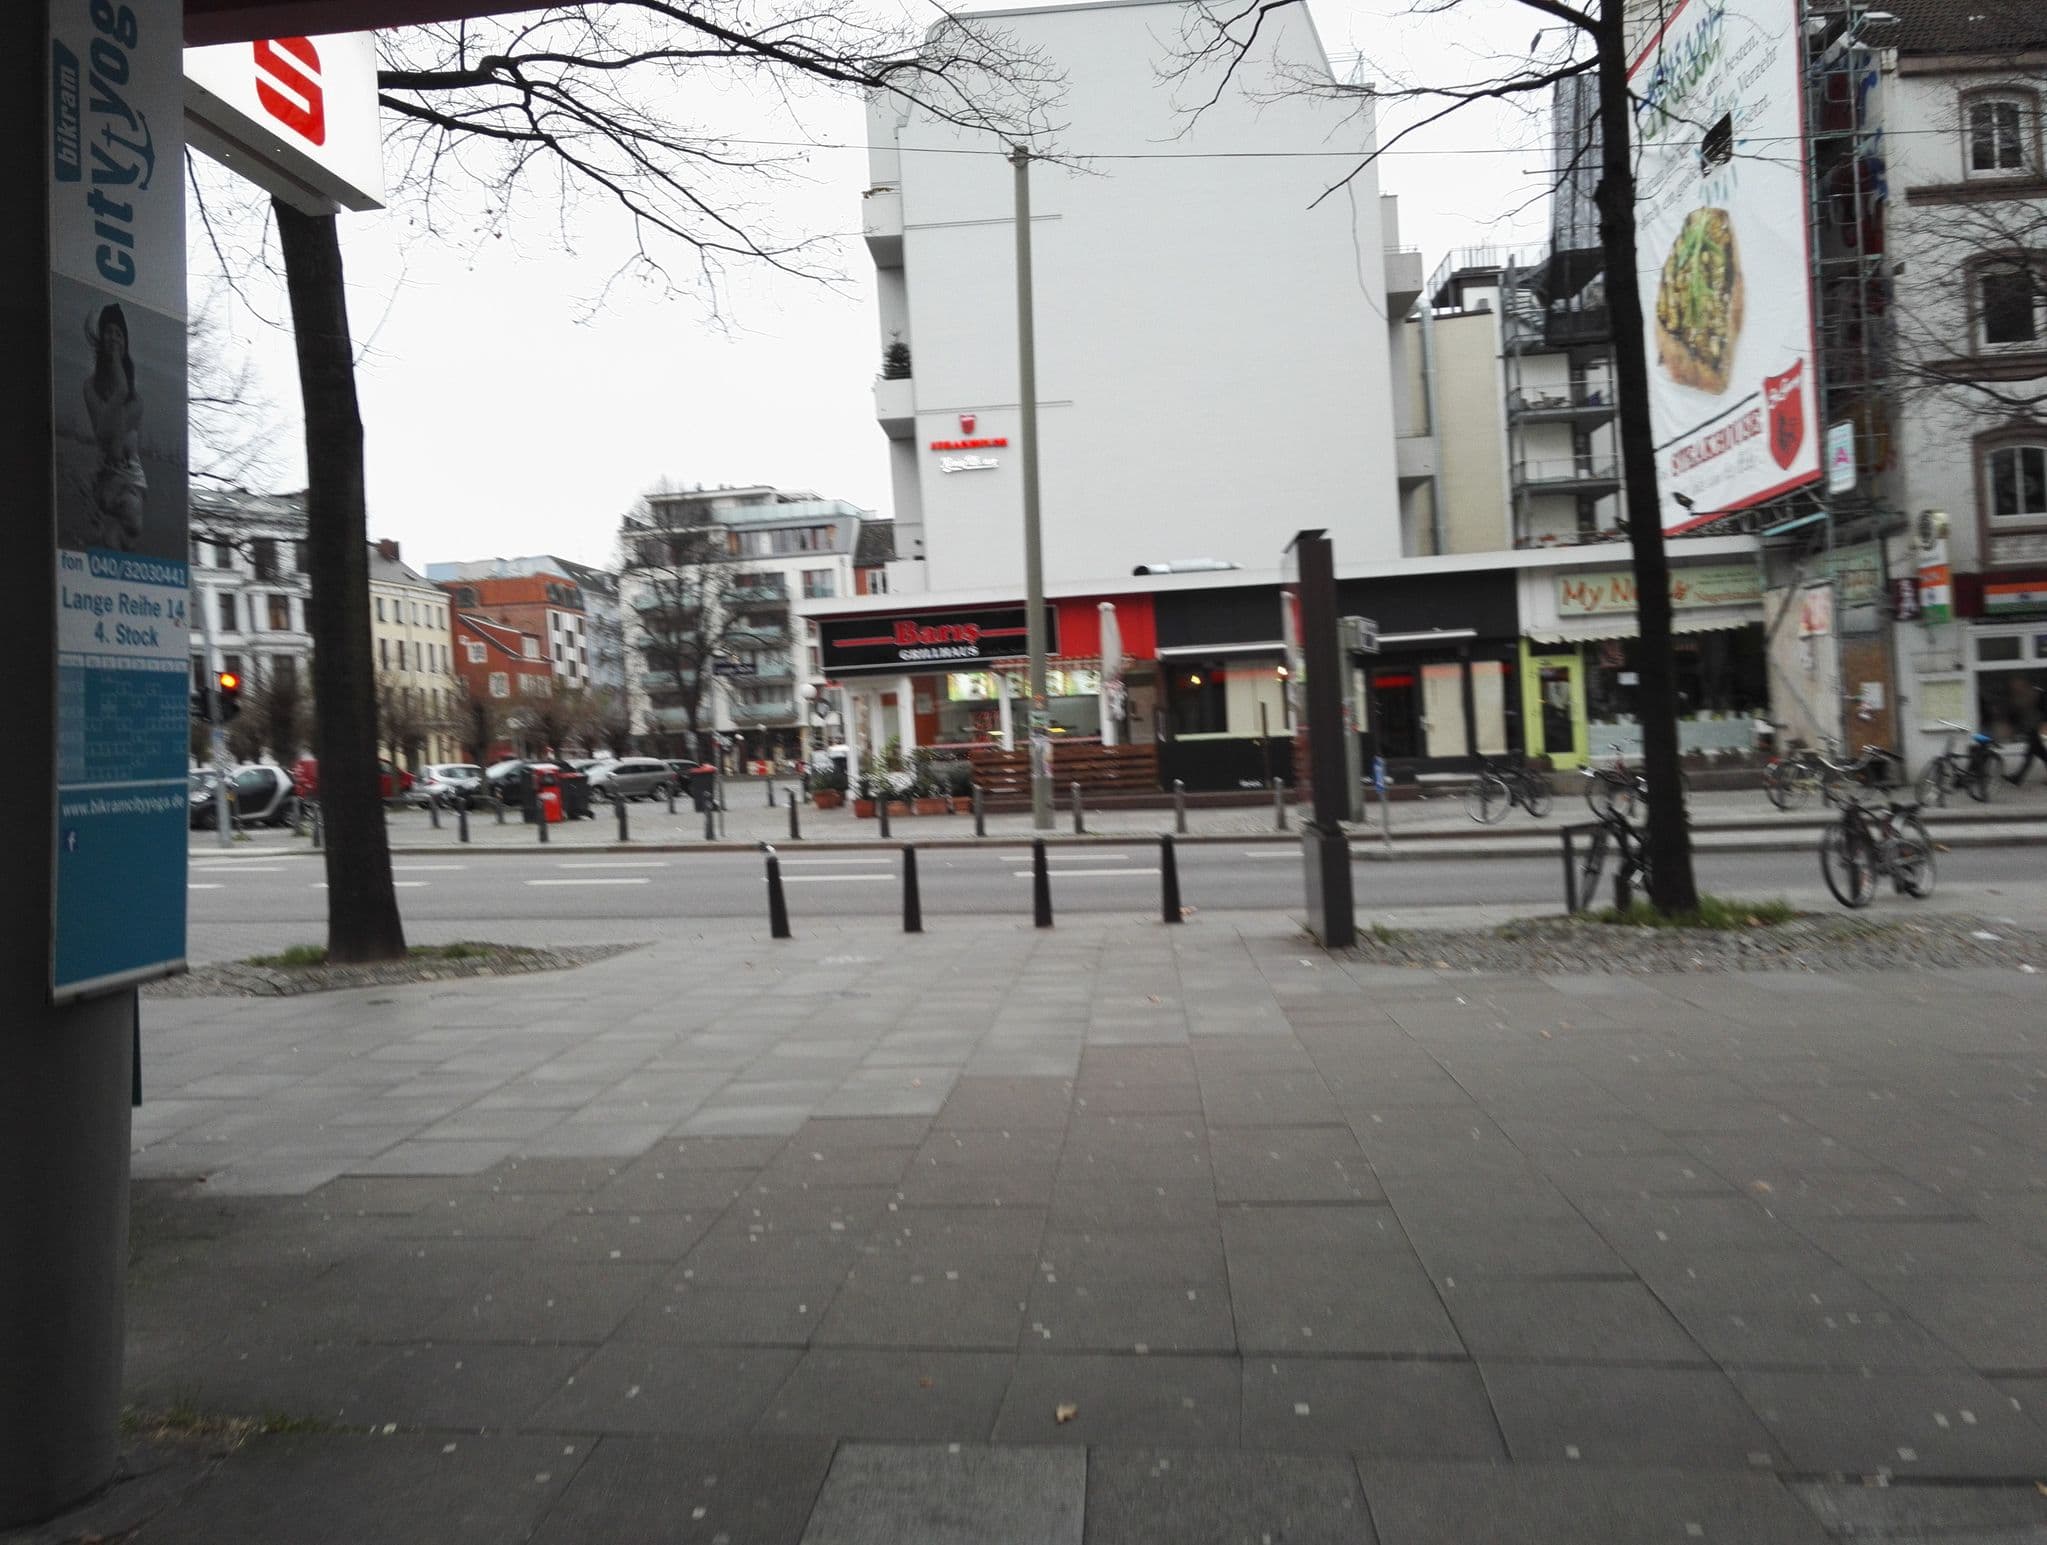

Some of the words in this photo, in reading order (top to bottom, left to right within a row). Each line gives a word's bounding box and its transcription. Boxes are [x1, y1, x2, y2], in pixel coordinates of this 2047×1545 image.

[57, 68, 80, 167] bikram
[61, 552, 83, 571] fon
[62, 587, 113, 616] Lange
[119, 592, 161, 618] Reihe
[167, 597, 185, 619] 14
[1561, 578, 1604, 611] My
[95, 621, 110, 644] 4.
[115, 623, 160, 648] Stock
